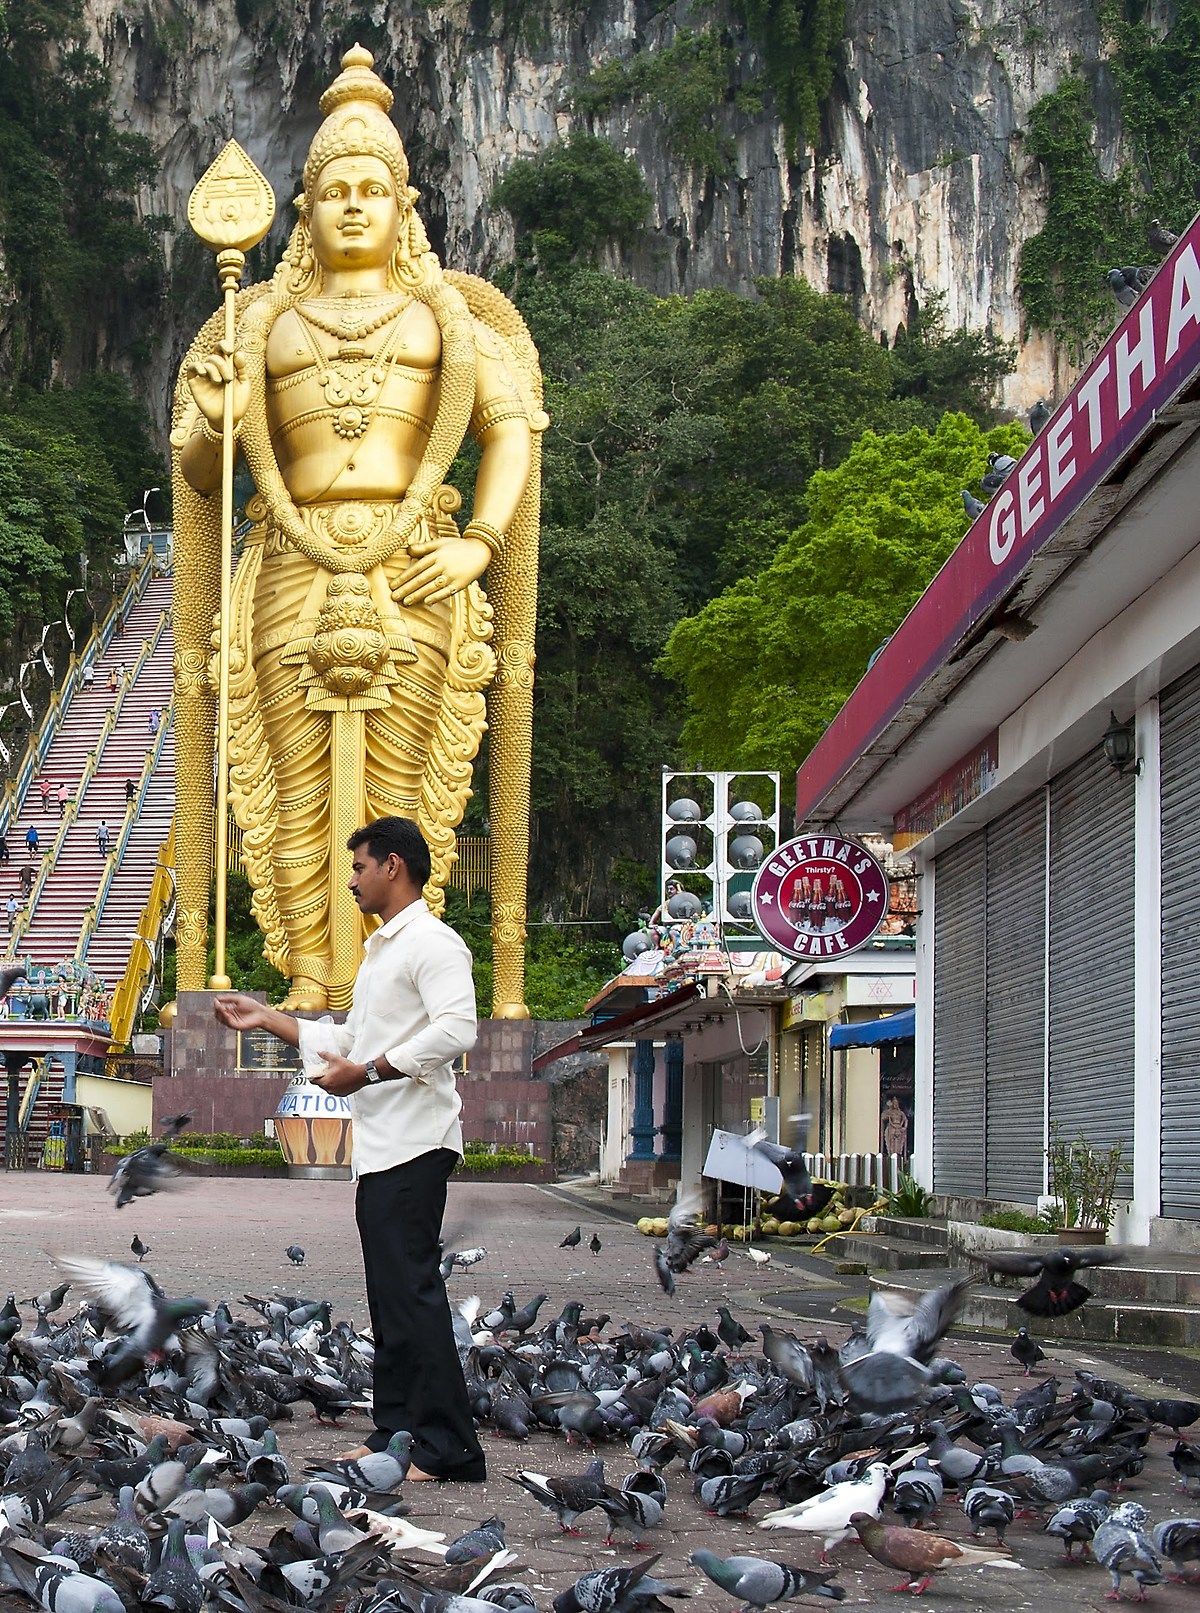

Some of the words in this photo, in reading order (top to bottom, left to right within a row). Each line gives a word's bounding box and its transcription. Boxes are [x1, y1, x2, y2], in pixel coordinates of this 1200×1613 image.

[989, 243, 1200, 565] GEETHA
[768, 840, 872, 877] GEETHA'S
[804, 866, 836, 875] Thirsty?
[793, 932, 849, 954] CAFE
